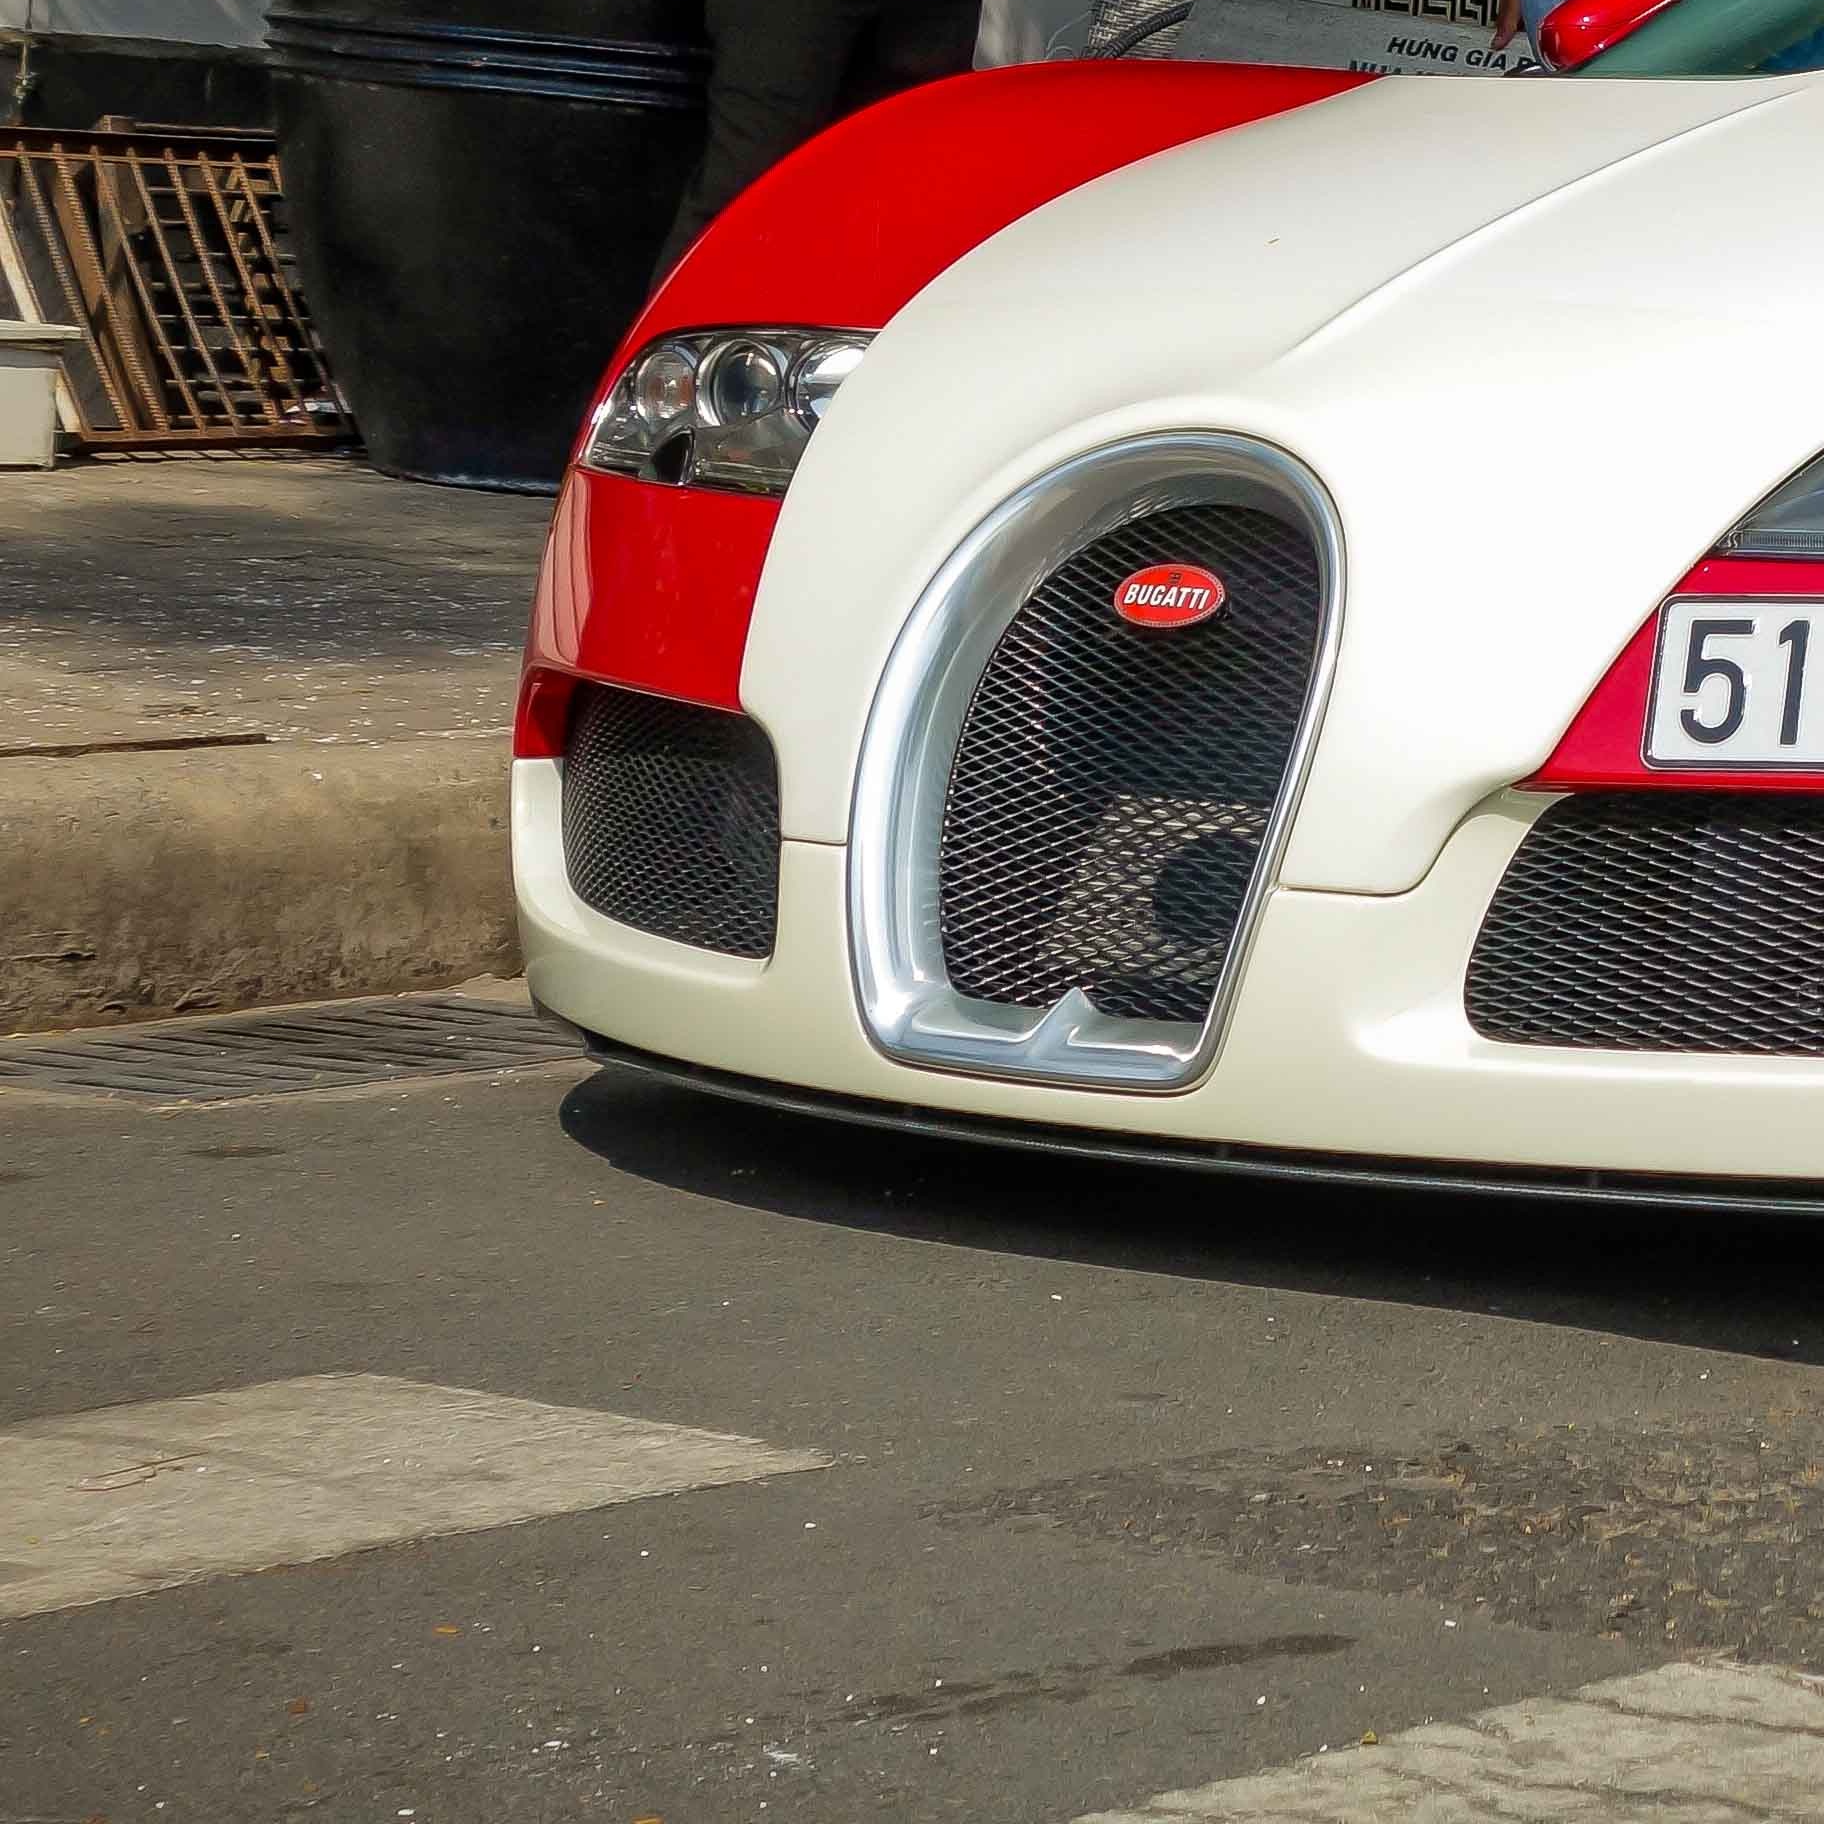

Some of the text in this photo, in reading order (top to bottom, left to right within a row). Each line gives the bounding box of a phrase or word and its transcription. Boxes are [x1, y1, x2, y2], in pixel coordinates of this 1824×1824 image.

[1386, 36, 1458, 63] HƯNG
[1465, 48, 1507, 72] GIA
[1123, 583, 1211, 610] BUGATTI
